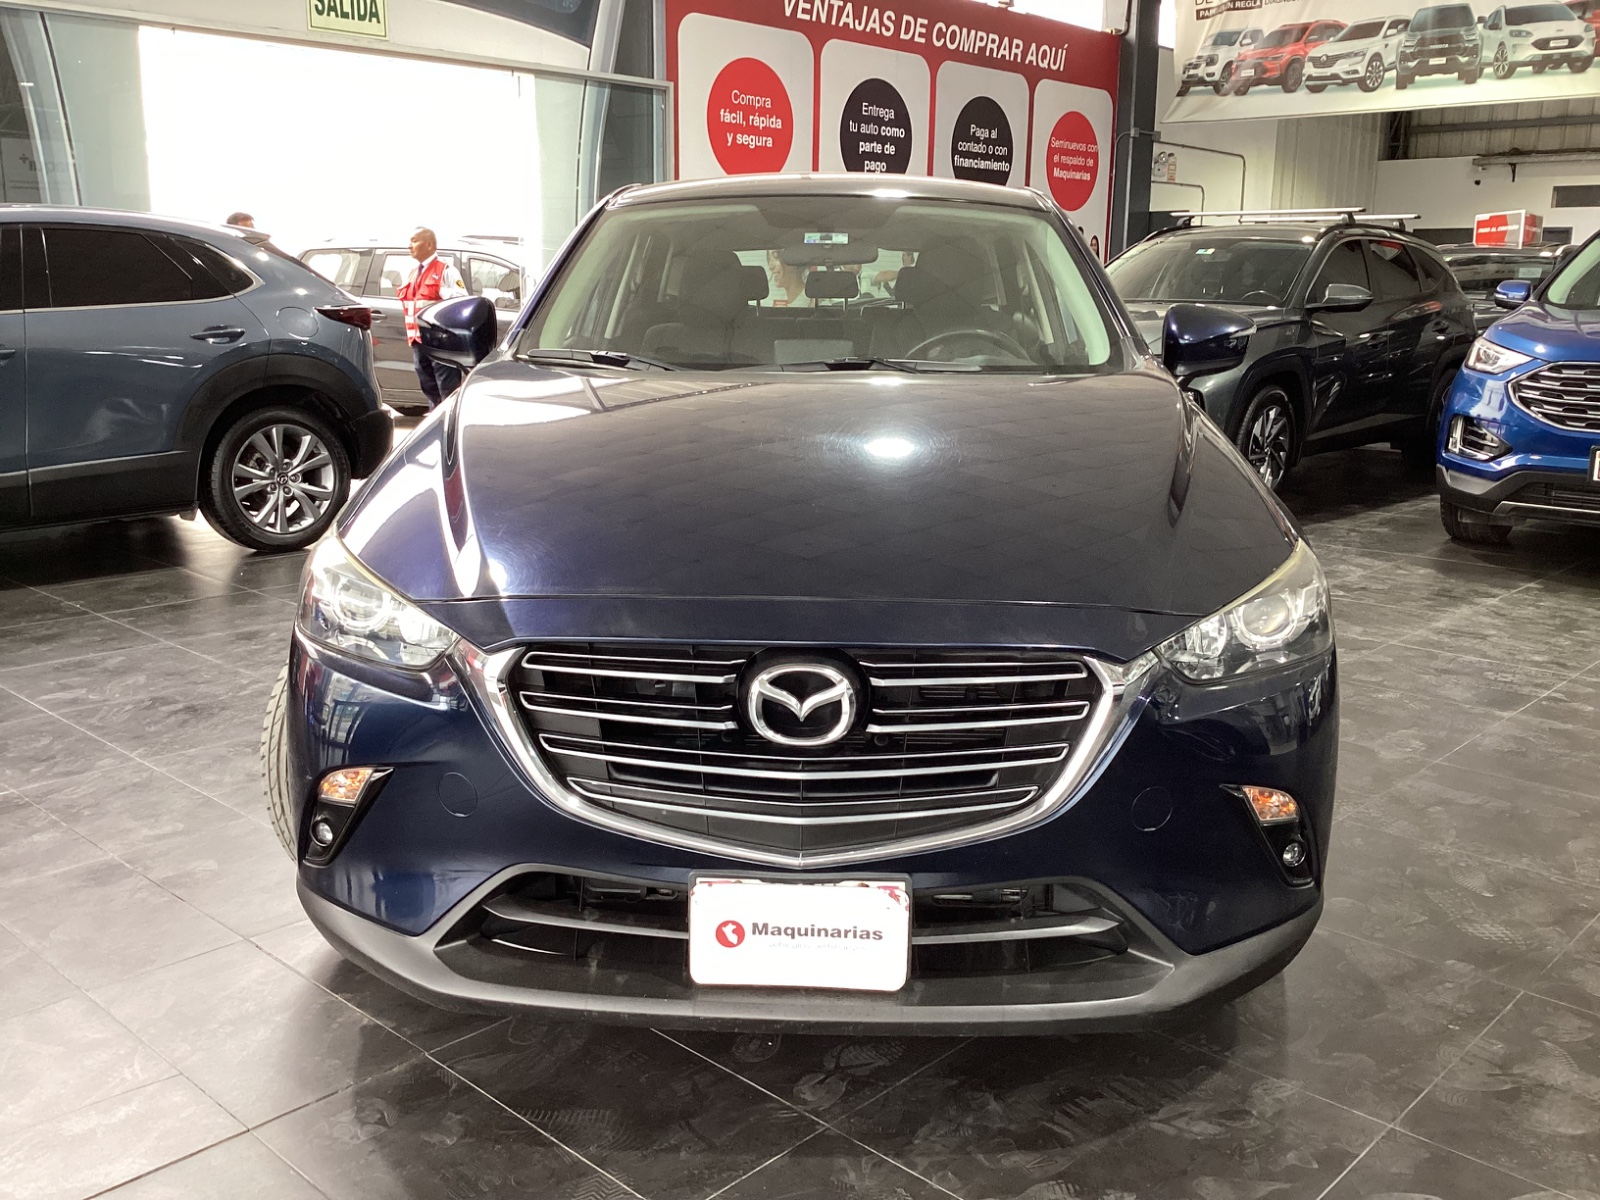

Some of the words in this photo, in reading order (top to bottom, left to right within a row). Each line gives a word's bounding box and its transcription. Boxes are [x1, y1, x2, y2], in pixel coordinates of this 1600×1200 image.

[314, 0, 381, 24] SALIDA
[1235, 0, 1261, 9] REGLA
[783, 0, 896, 37] VENTAJAS
[899, 14, 929, 44] DE
[932, 21, 1024, 63] COMPRAR
[1025, 43, 1068, 71] AQUÍ
[731, 90, 772, 109] Compra
[720, 108, 746, 127] fácil,
[749, 113, 782, 130] rápida
[862, 102, 895, 121] Entrega
[849, 119, 858, 132] tu
[860, 122, 879, 135] auto
[880, 126, 905, 138] como
[970, 124, 989, 140] Paga
[990, 127, 998, 139] al
[726, 132, 734, 146] y
[736, 133, 773, 149] segura
[859, 141, 883, 154] parte
[884, 142, 896, 155] de
[957, 141, 987, 153] contado
[988, 145, 994, 154] o
[994, 146, 1008, 156] con
[1051, 136, 1086, 151] Seminuevos
[1087, 144, 1099, 153] con
[864, 160, 887, 173] pago
[954, 154, 1010, 172] financiamiento
[1053, 153, 1060, 163] el
[1060, 155, 1085, 167] respaldo
[1086, 157, 1094, 167] de
[1053, 167, 1091, 181] Maquinarias
[751, 922, 884, 940] Maquinarias
